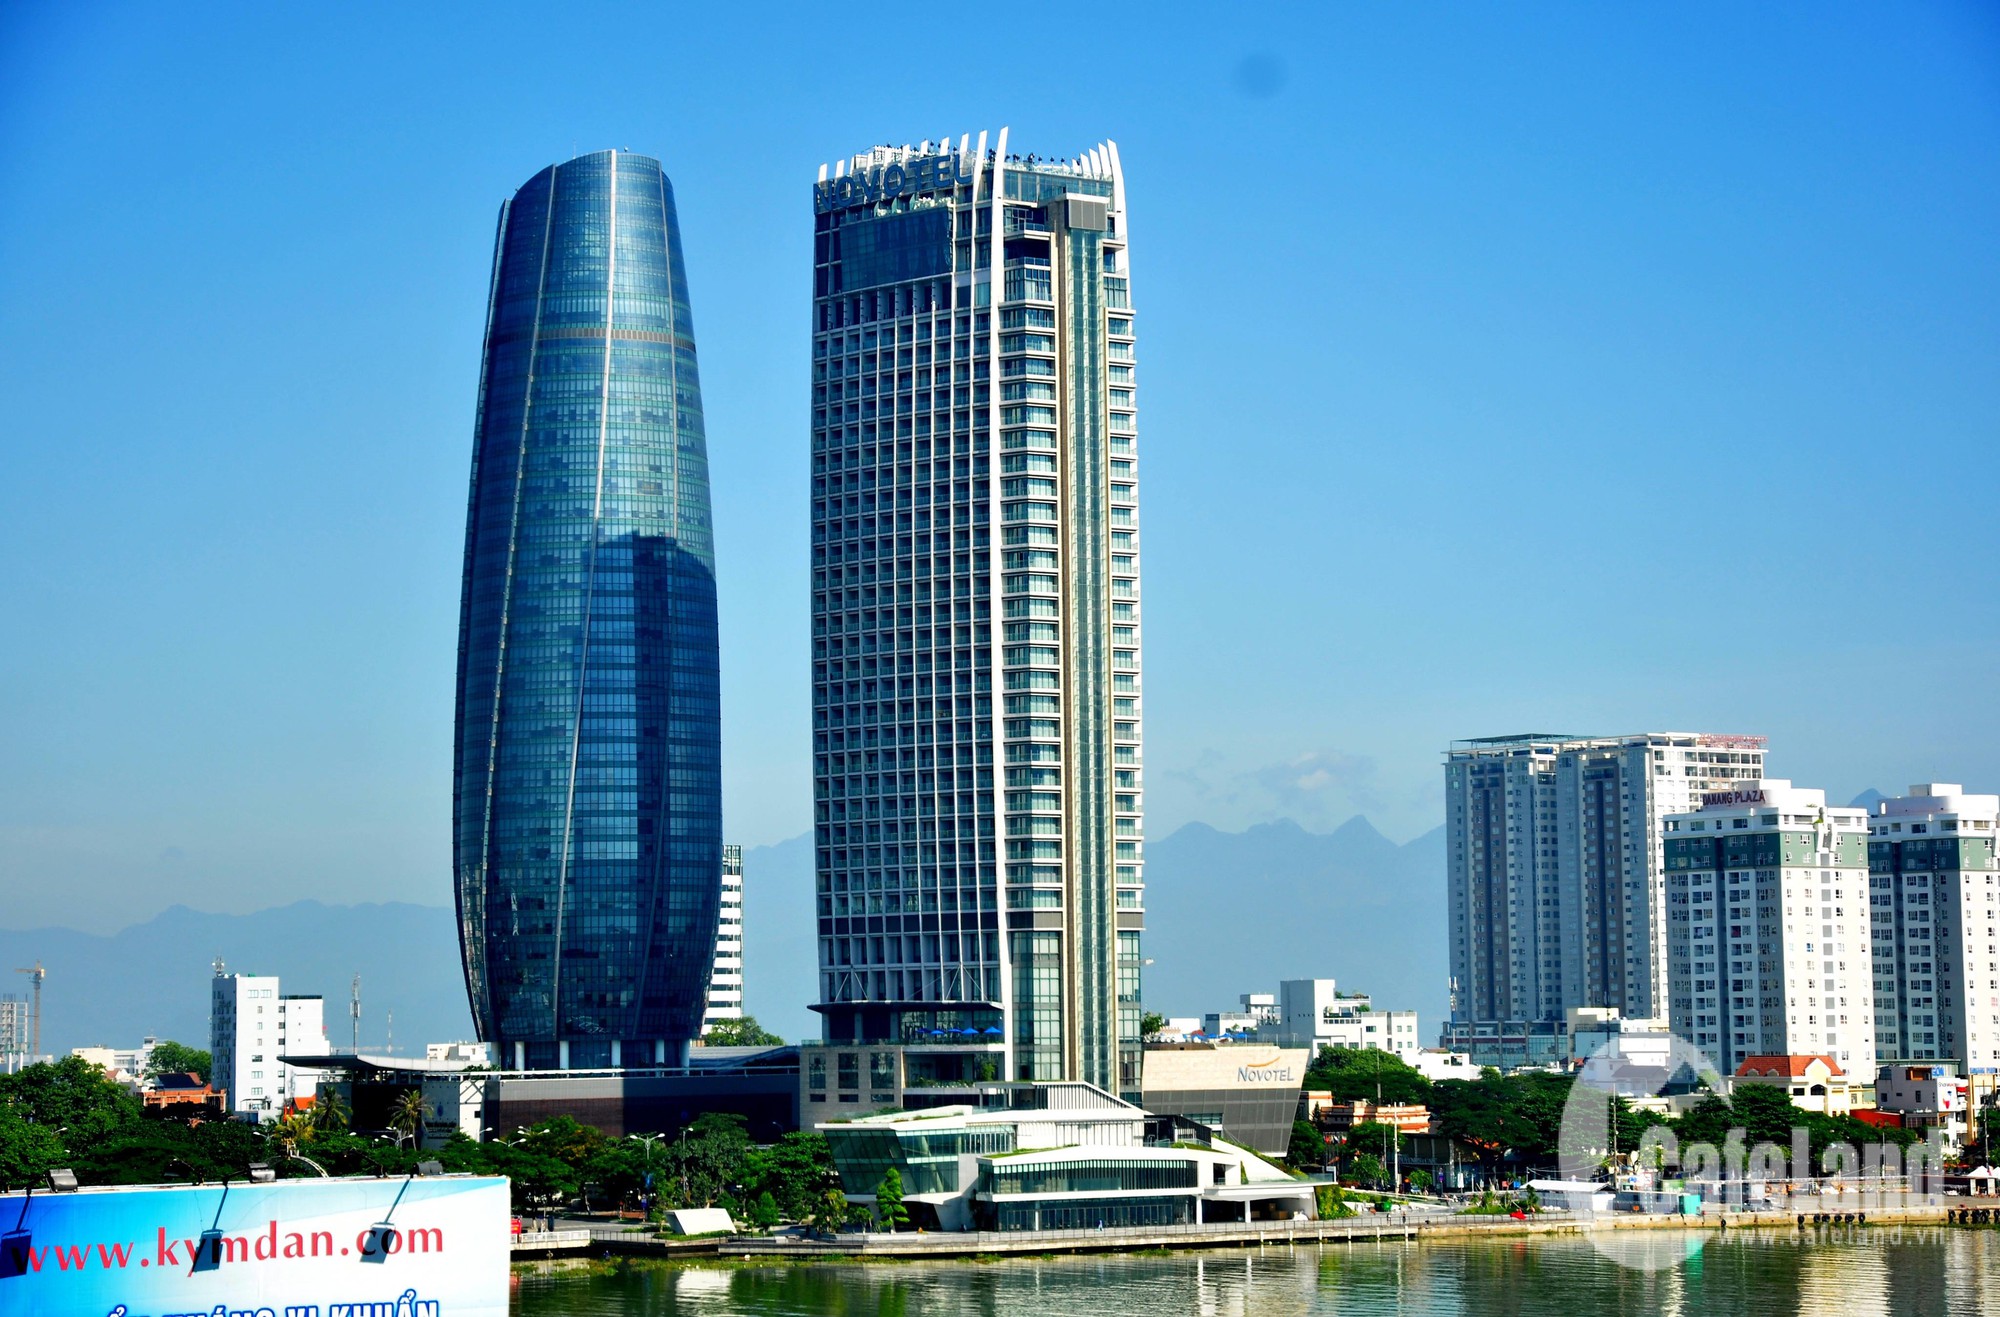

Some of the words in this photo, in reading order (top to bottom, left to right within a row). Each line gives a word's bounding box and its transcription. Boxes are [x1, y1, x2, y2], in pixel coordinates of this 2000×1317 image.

[813, 153, 973, 215] NOVOTEL
[1702, 792, 1733, 806] DANANG
[1734, 789, 1766, 804] PLAZA
[1237, 1066, 1294, 1082] NOVOTEL
[11, 1220, 443, 1277] www.kymdan.com
